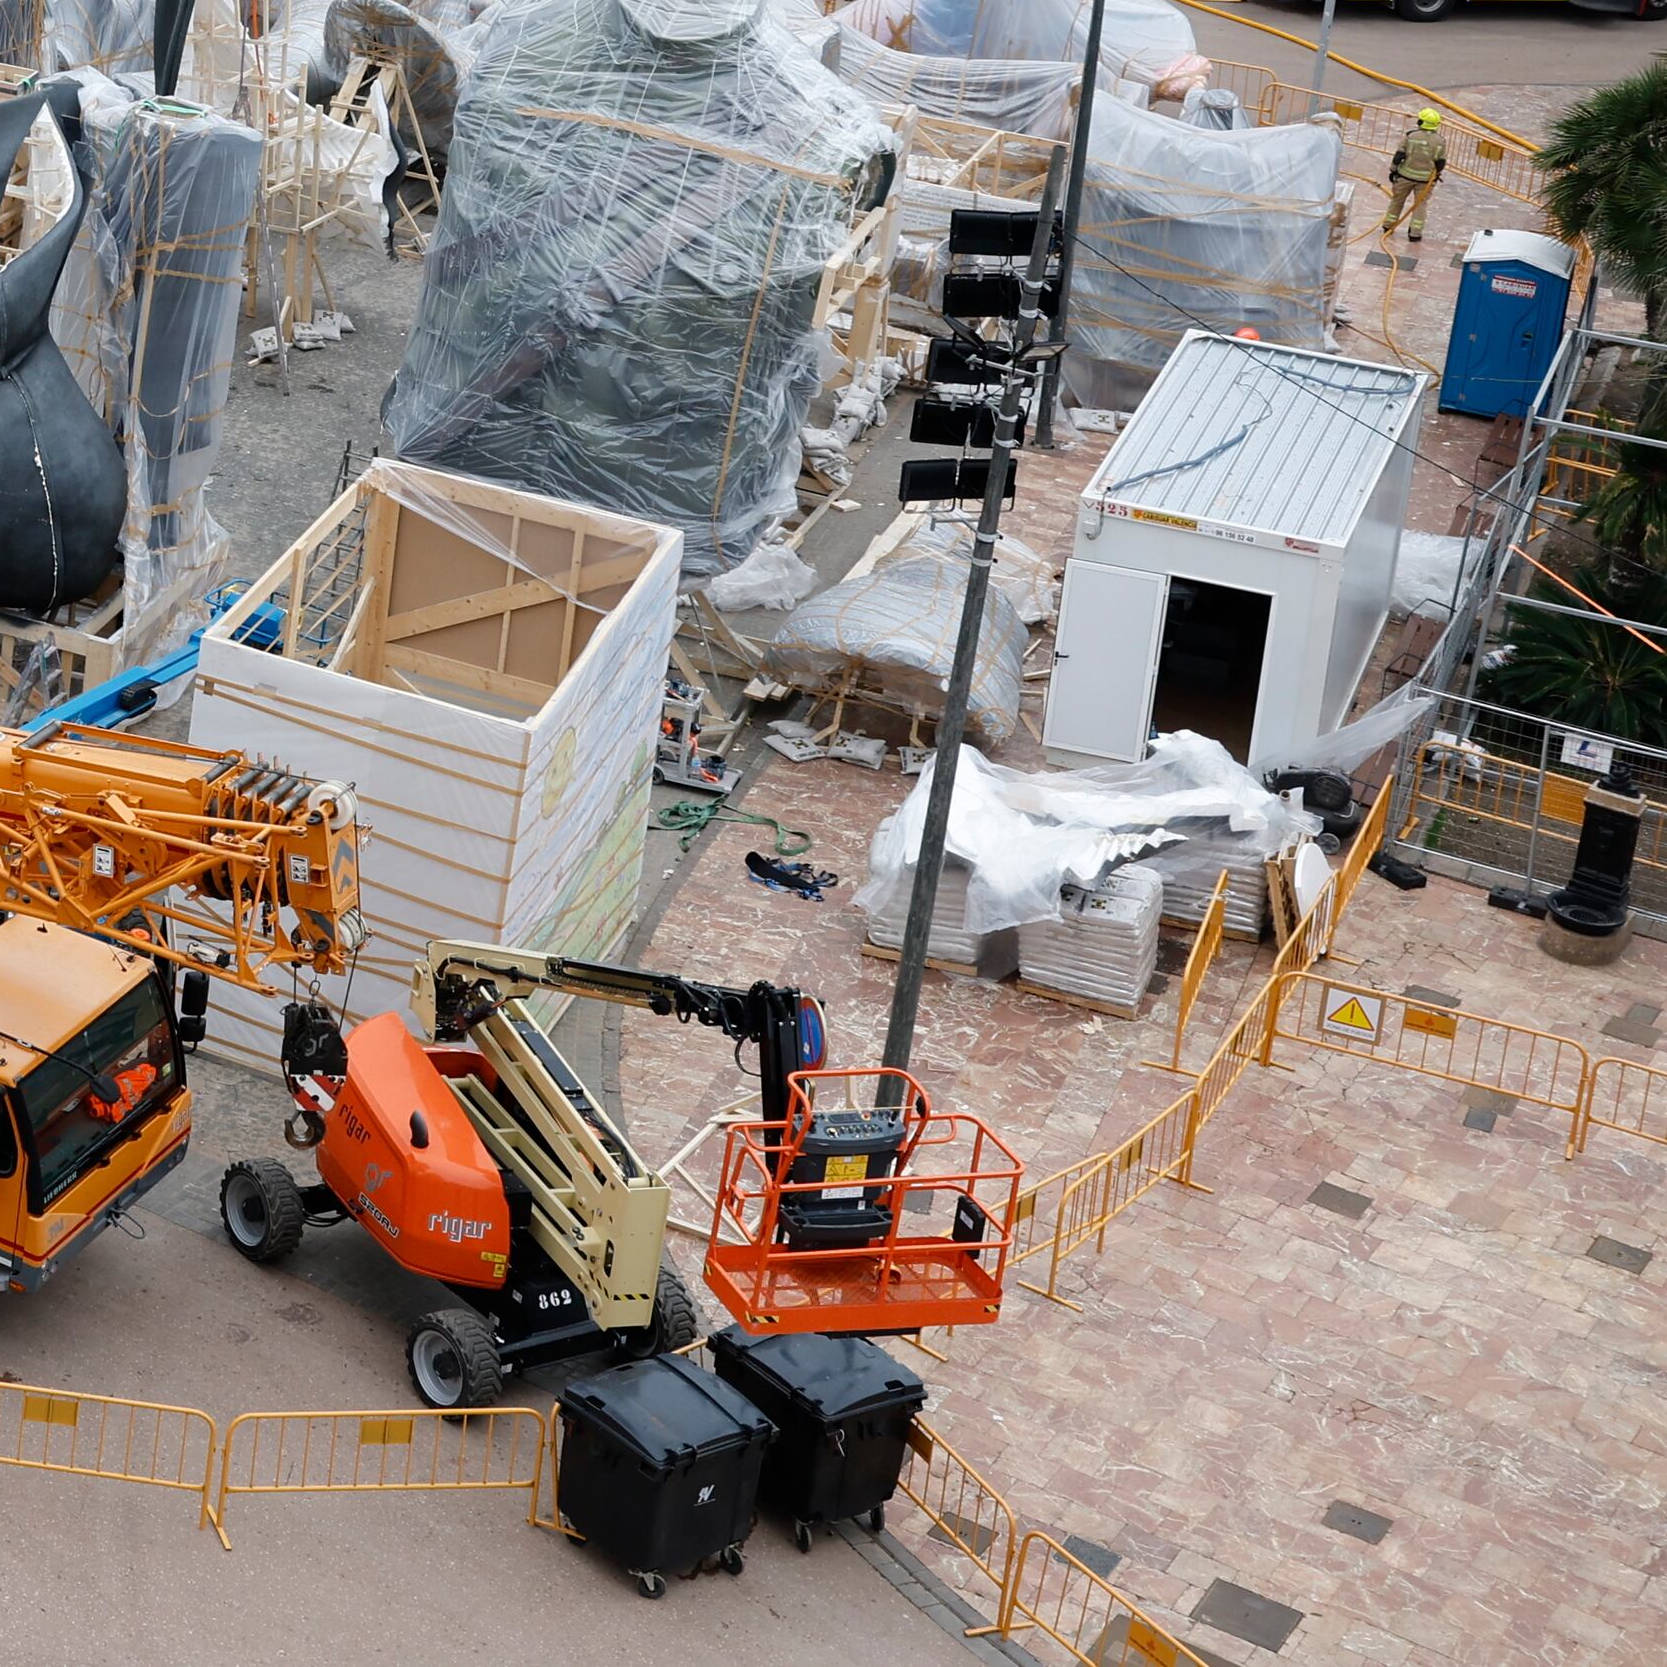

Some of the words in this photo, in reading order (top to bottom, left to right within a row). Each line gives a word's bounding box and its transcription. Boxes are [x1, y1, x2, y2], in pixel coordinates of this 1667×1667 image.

[339, 1102, 371, 1145] rigar
[358, 1192, 400, 1239] 520AJ
[428, 1210, 492, 1244] rigar
[538, 1289, 573, 1310] 862
